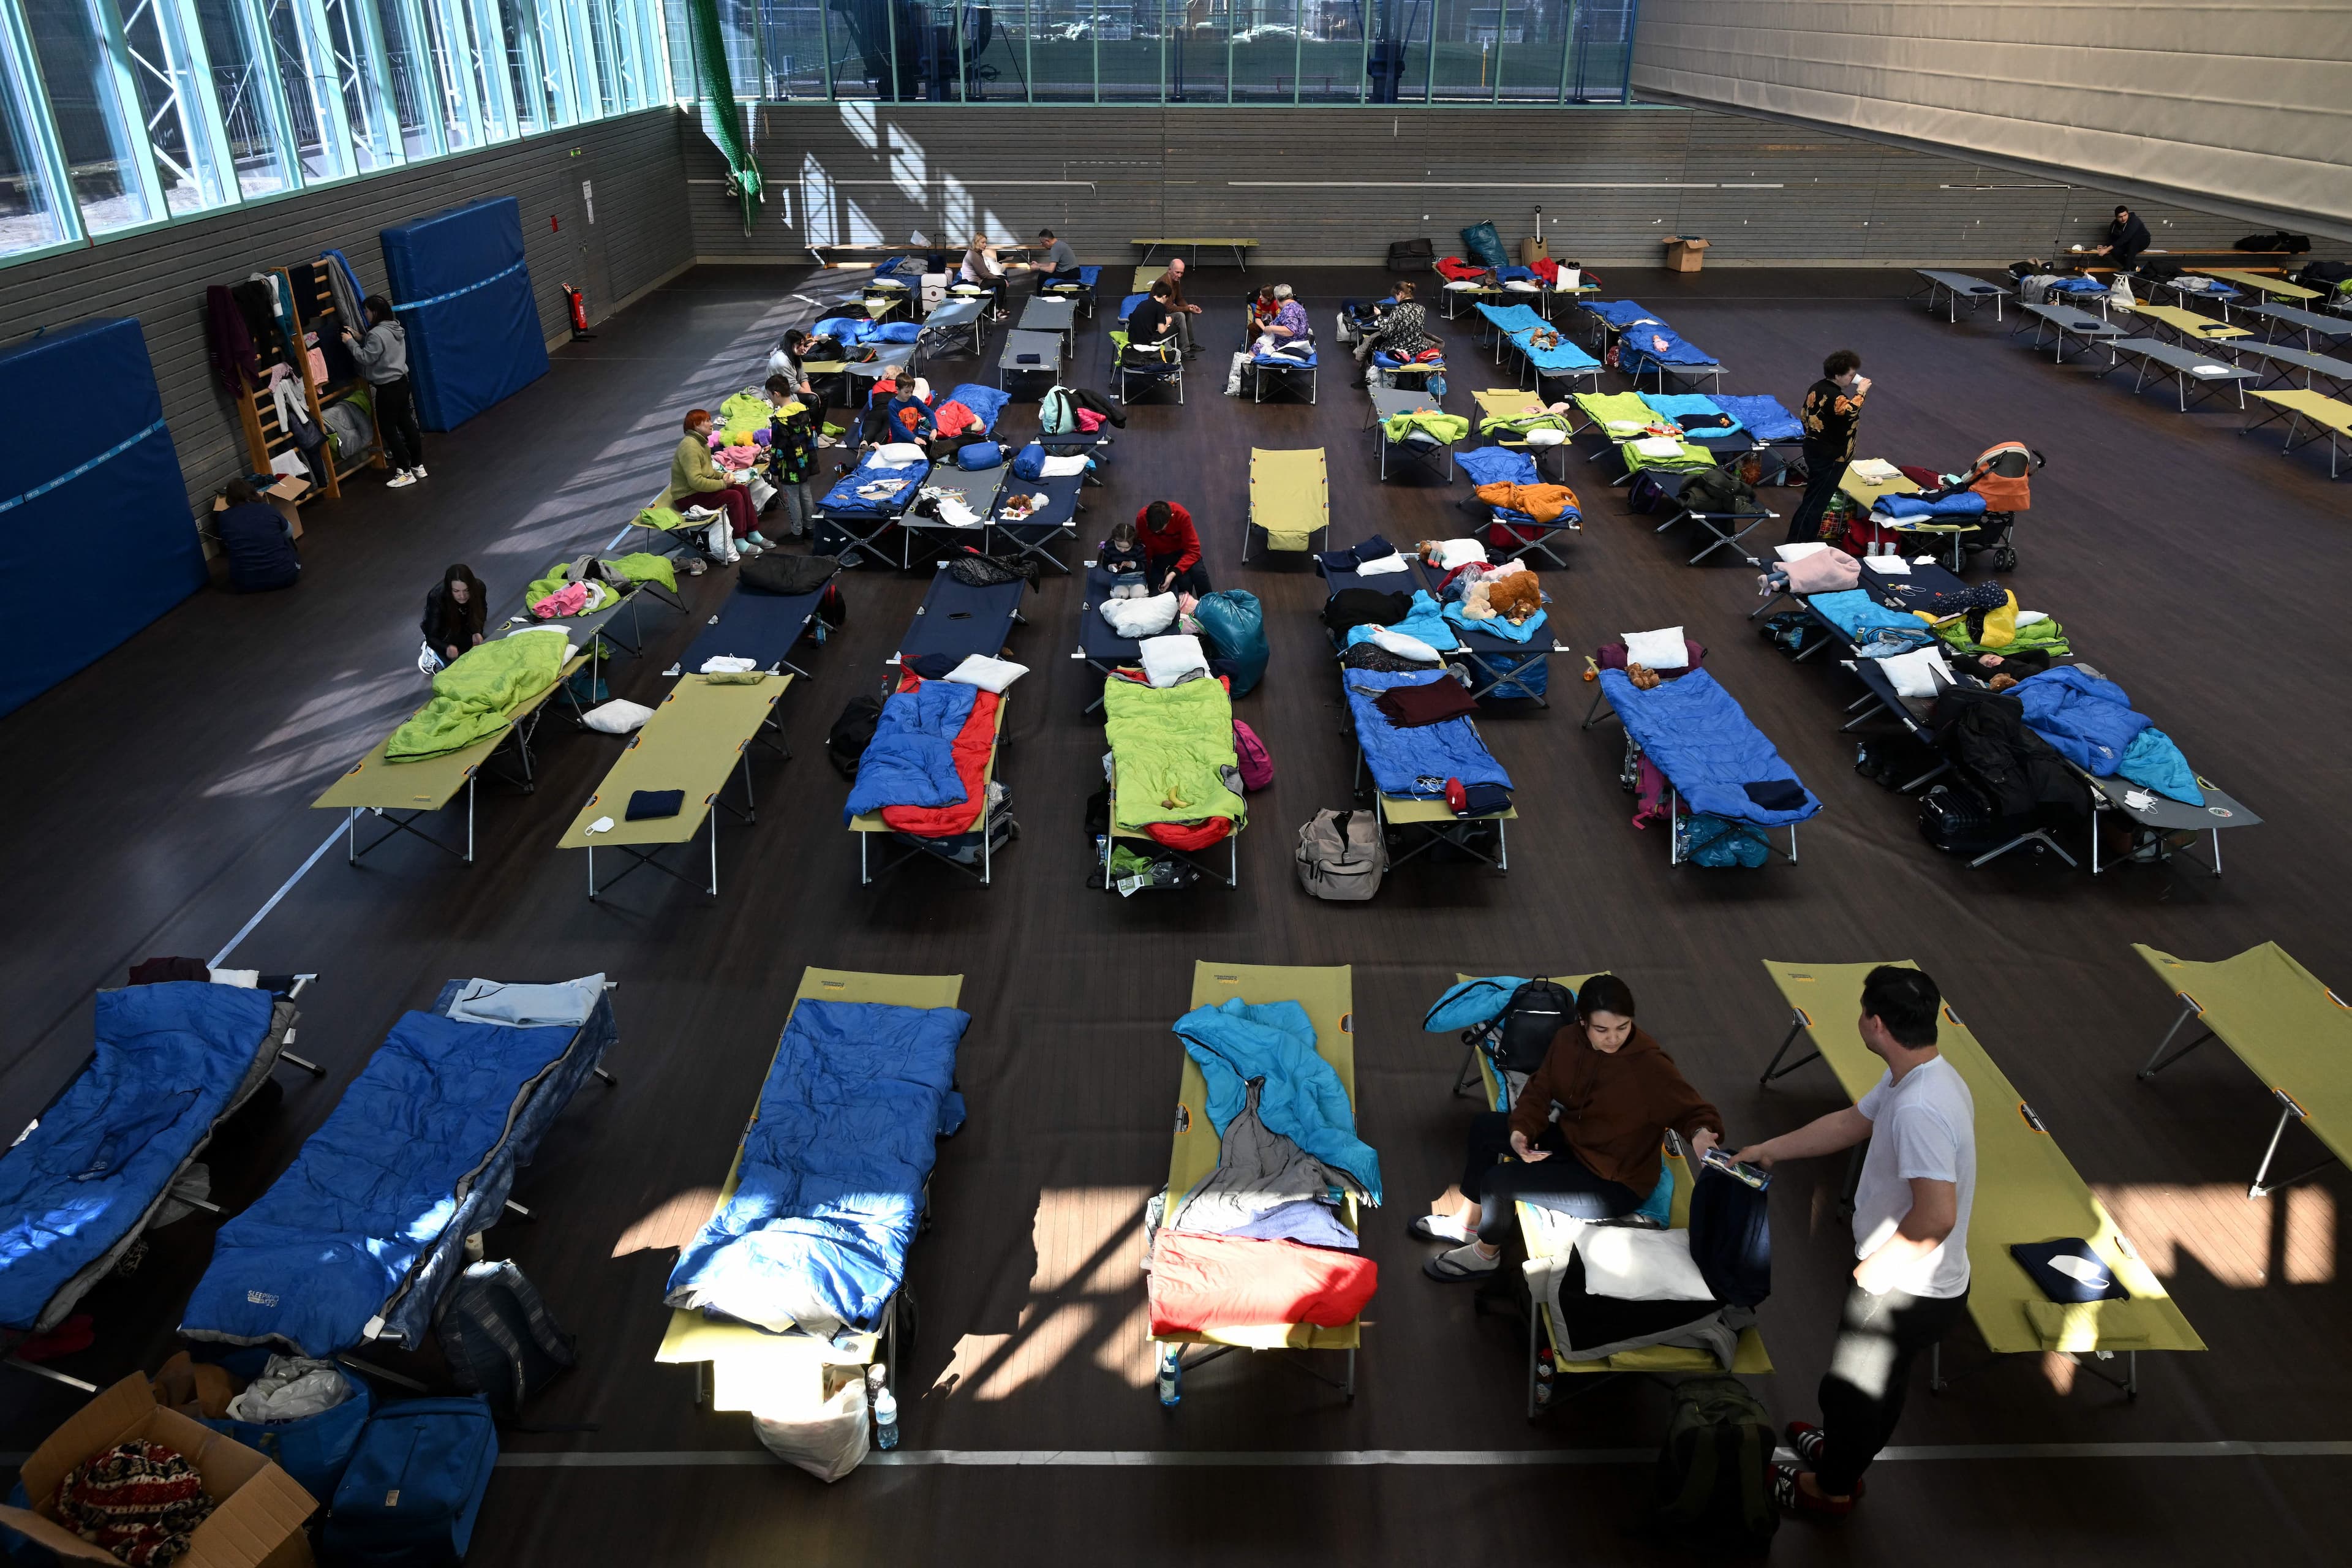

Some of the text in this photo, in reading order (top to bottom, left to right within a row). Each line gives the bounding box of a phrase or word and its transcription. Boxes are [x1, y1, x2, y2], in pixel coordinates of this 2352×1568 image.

[0, 501, 13, 511] PORTCO
[26, 489, 39, 499] PORTCO
[50, 477, 65, 488] SPORTCO
[74, 464, 89, 475] SPORTCO
[97, 453, 111, 463] SPORTCO
[119, 440, 132, 451] SPORTCO
